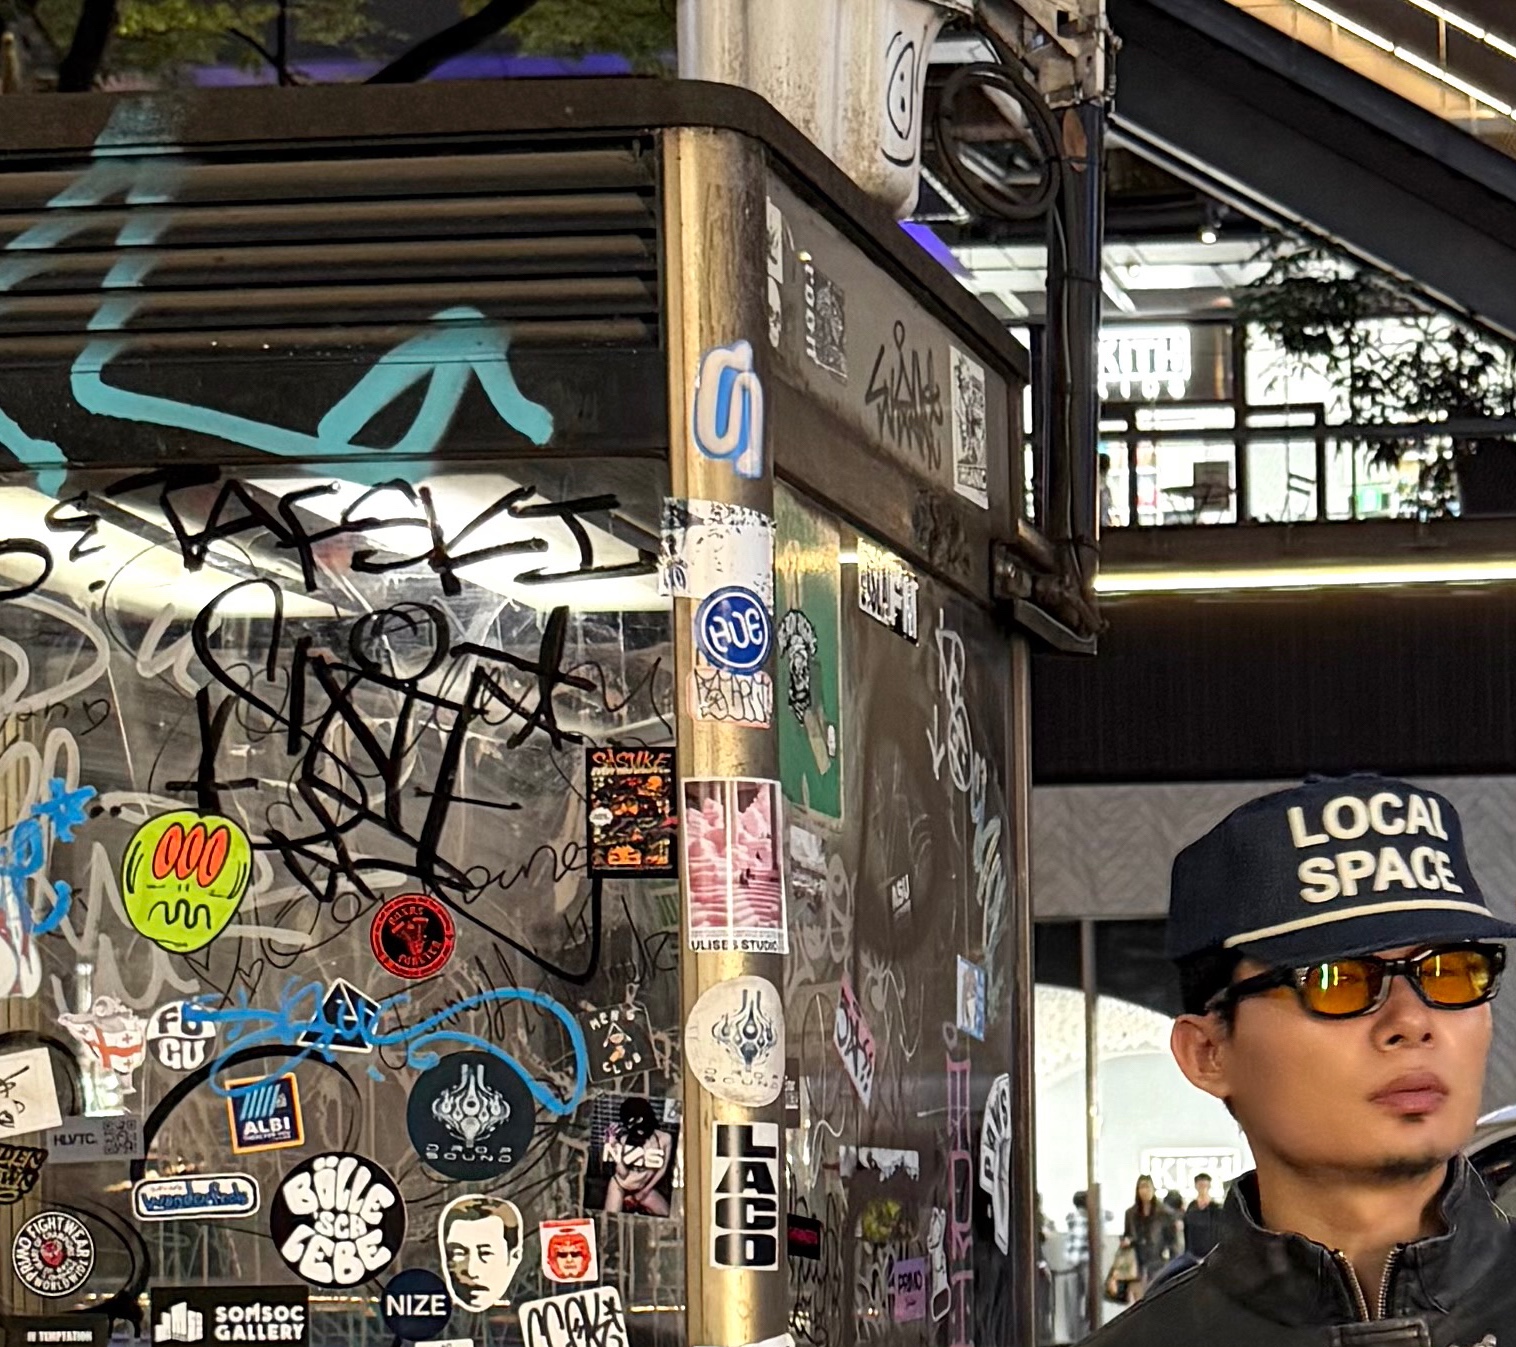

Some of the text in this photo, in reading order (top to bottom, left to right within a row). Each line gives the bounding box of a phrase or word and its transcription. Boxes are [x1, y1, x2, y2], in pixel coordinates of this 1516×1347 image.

[592, 748, 672, 768] SASUKE
[1287, 793, 1448, 848] LOCAL
[1298, 846, 1464, 903] SPACE
[158, 1038, 205, 1070] GU
[602, 1052, 642, 1075] CLUB
[243, 1116, 291, 1136] ALBI
[715, 1125, 778, 1267] LACO
[281, 1223, 392, 1284] LEBE
[215, 1302, 305, 1323] SOMSOC
[386, 1294, 447, 1316] NIZE
[215, 1323, 305, 1341] GALLERY
